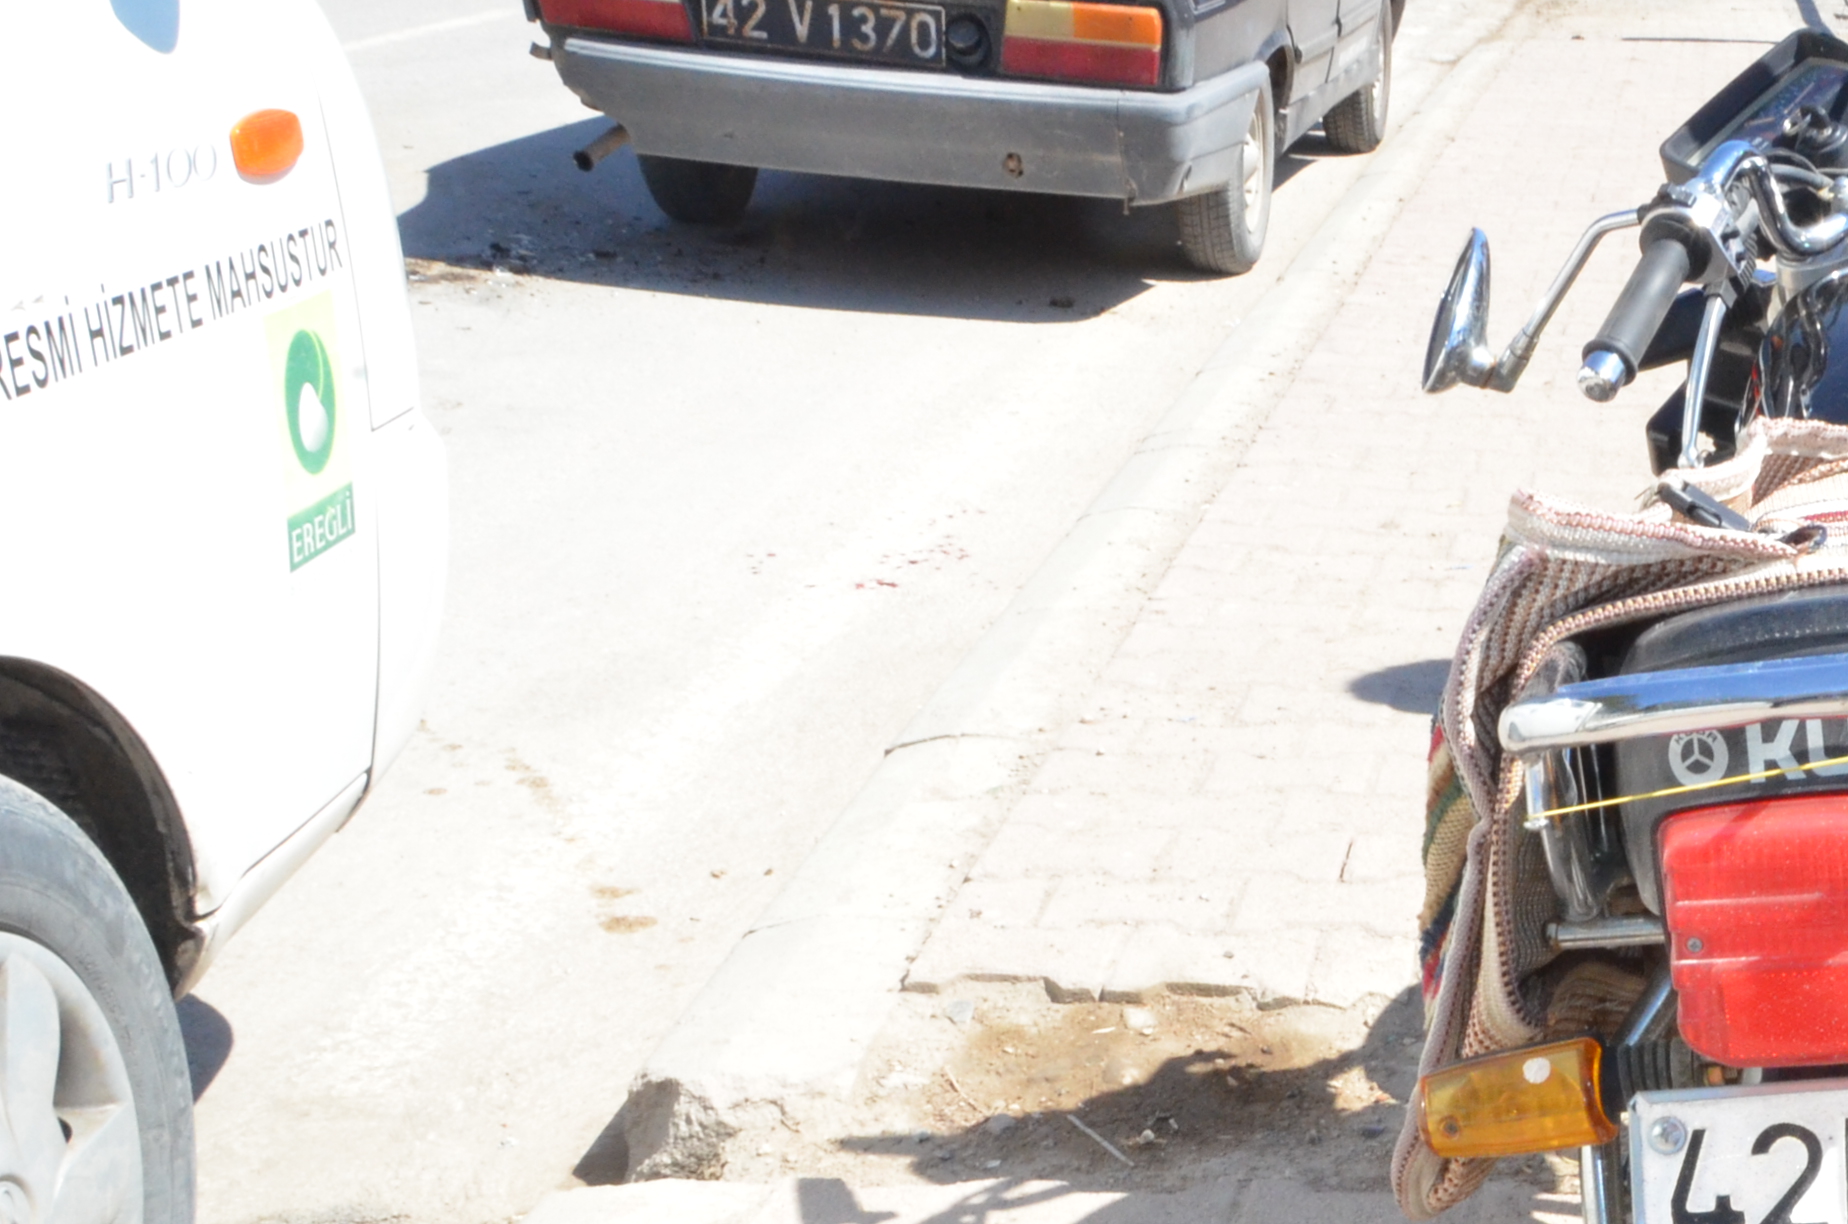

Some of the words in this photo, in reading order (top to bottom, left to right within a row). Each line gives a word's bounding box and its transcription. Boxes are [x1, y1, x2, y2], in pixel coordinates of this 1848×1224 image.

[711, 0, 768, 40] 42
[787, 0, 814, 43] V
[827, 3, 937, 59] 1370
[106, 143, 218, 204] H-100
[84, 269, 203, 367] HİZMETE
[204, 218, 343, 320] MAHSUSTUR
[292, 490, 353, 564] EREĞLİ
